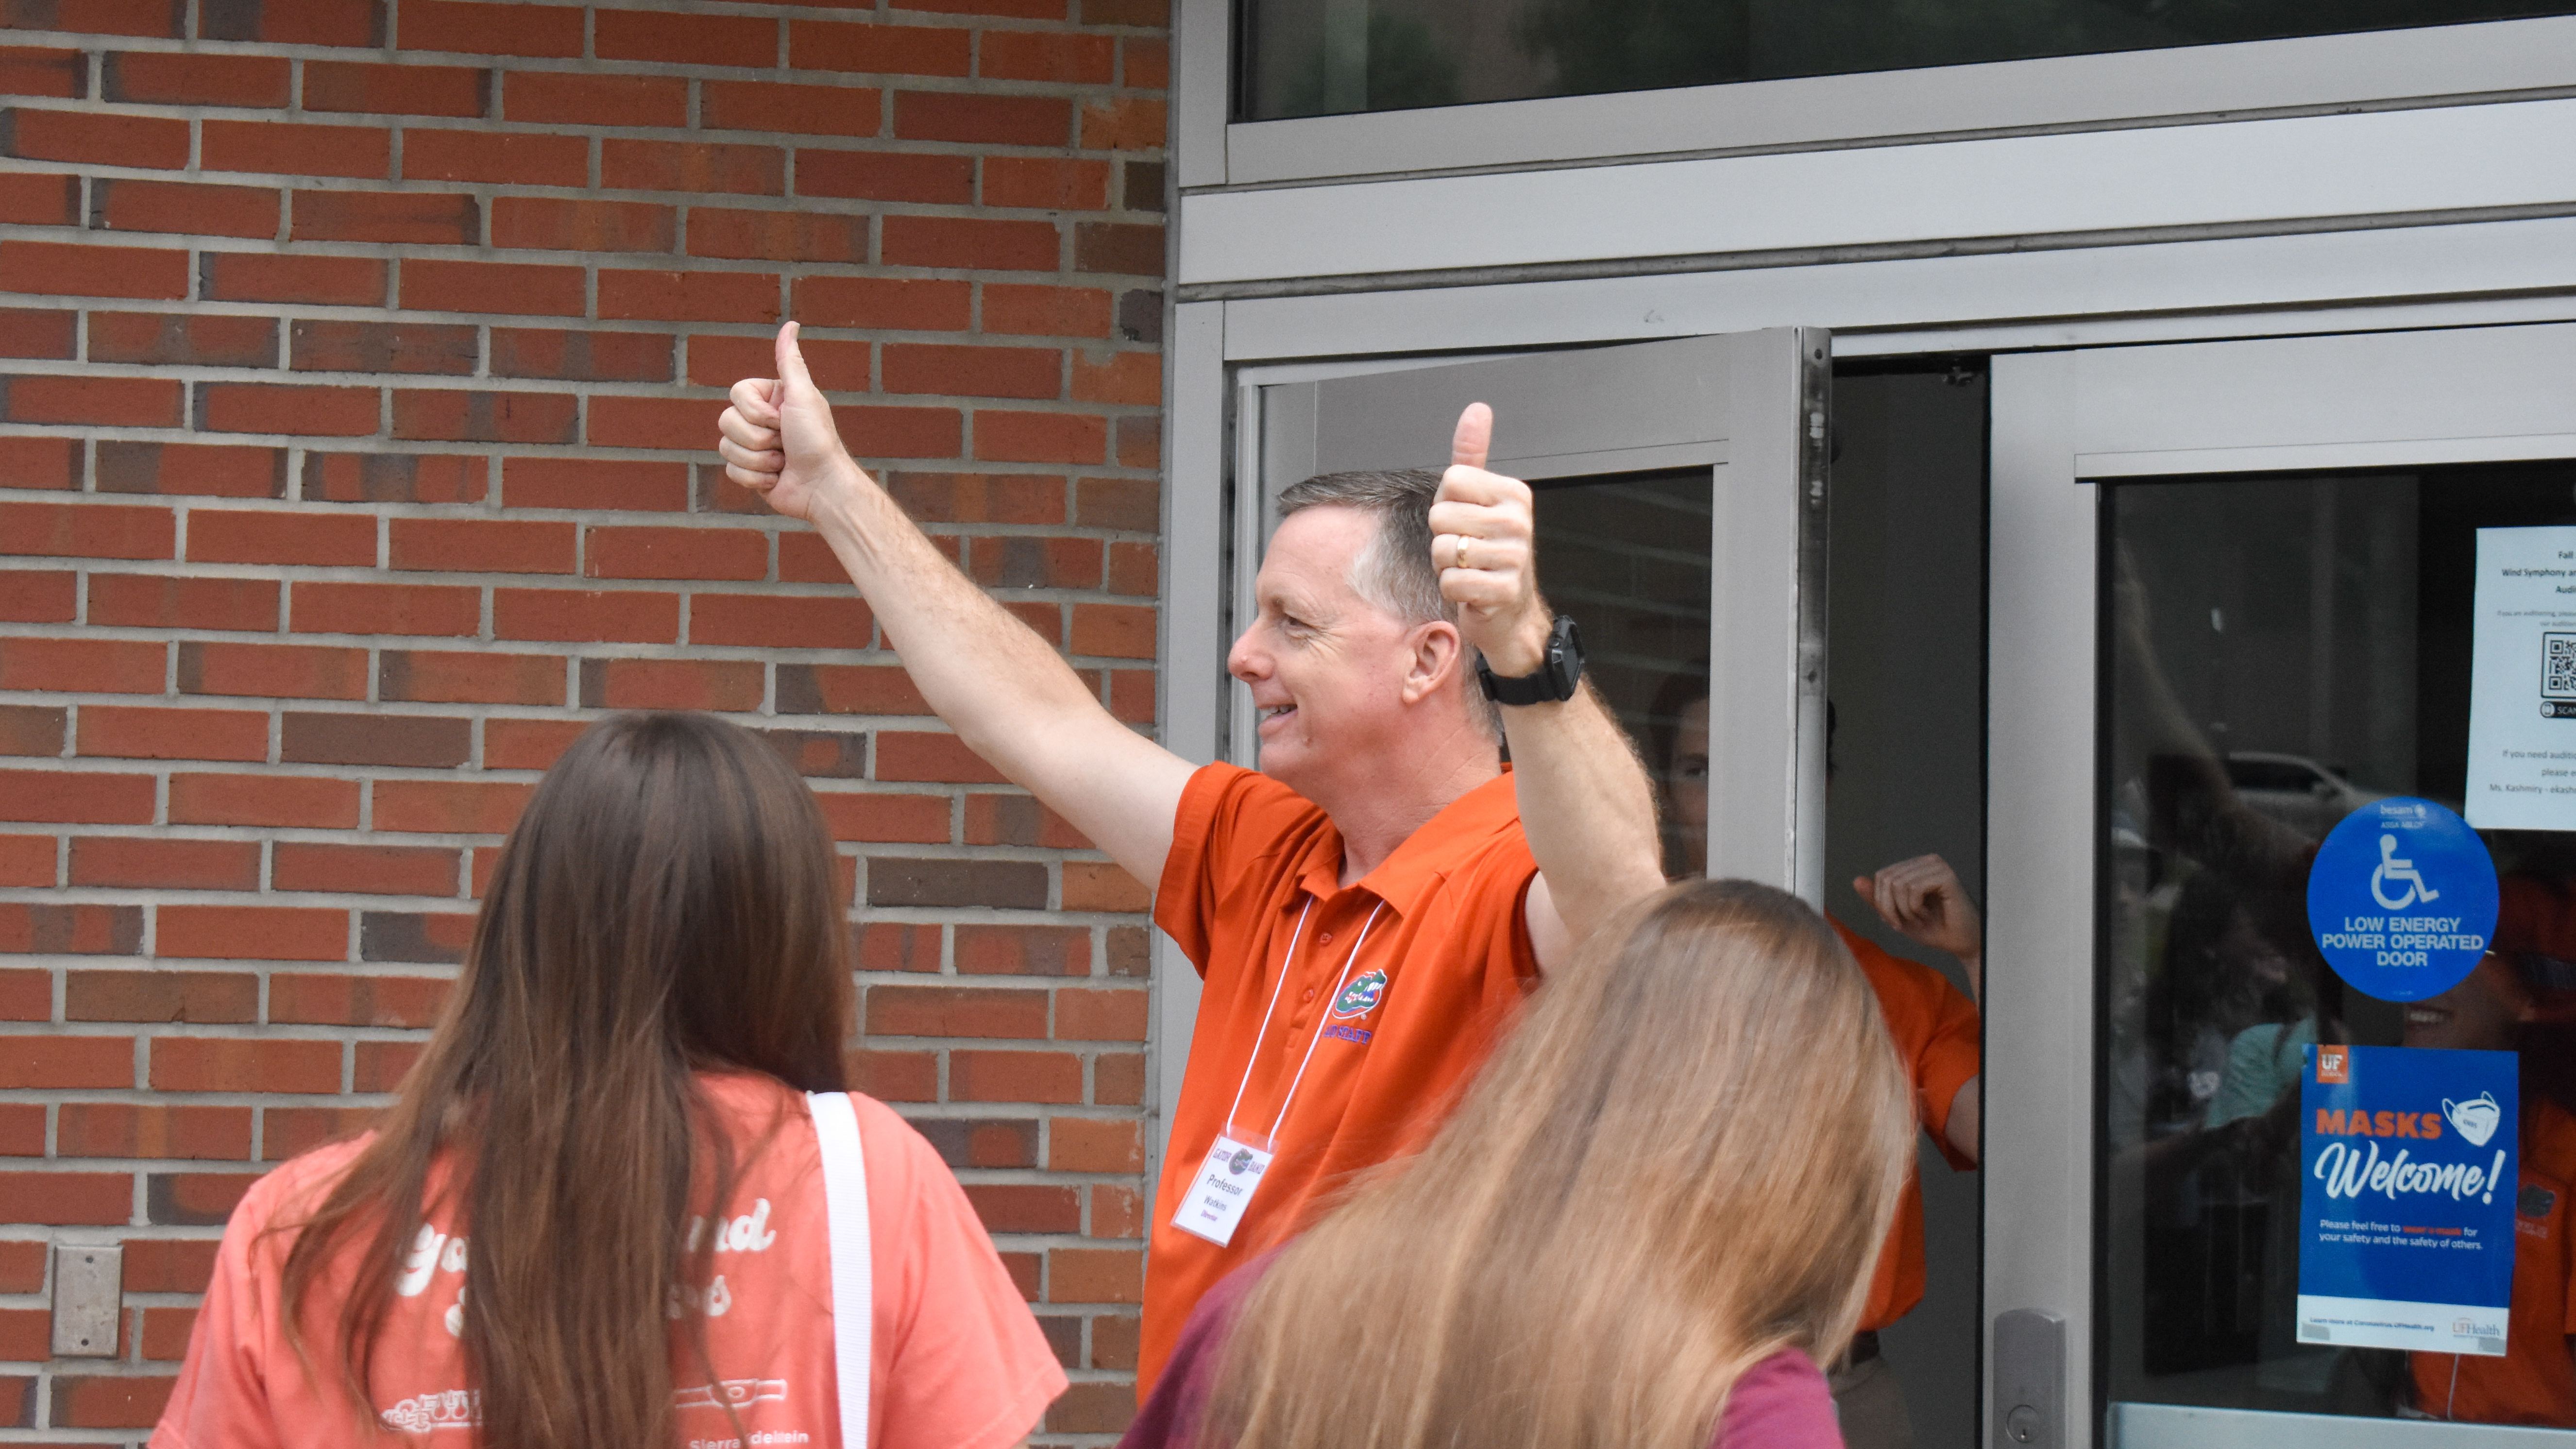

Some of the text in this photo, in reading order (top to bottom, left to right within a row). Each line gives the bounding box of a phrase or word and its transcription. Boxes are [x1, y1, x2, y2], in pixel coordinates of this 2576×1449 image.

[2524, 568, 2565, 577] Symphony
[2542, 768, 2568, 777] please
[2345, 917, 2461, 932] LOW ENERGY
[2322, 934, 2484, 950] POWER OPERATED
[2377, 951, 2428, 967] DOOR
[2322, 1054, 2342, 1070] UF
[2316, 1108, 2442, 1140] MASKS
[2314, 1140, 2506, 1204] Welcome!
[1206, 1174, 1243, 1196] Professor
[1203, 1194, 1227, 1211] Watkins
[2320, 1219, 2350, 1229] Please
[2352, 1220, 2369, 1230] feel
[2371, 1221, 2389, 1232] free
[2390, 1224, 2401, 1233] to
[2464, 1227, 2478, 1237] for
[2319, 1233, 2483, 1250] your safety and the safety of others.
